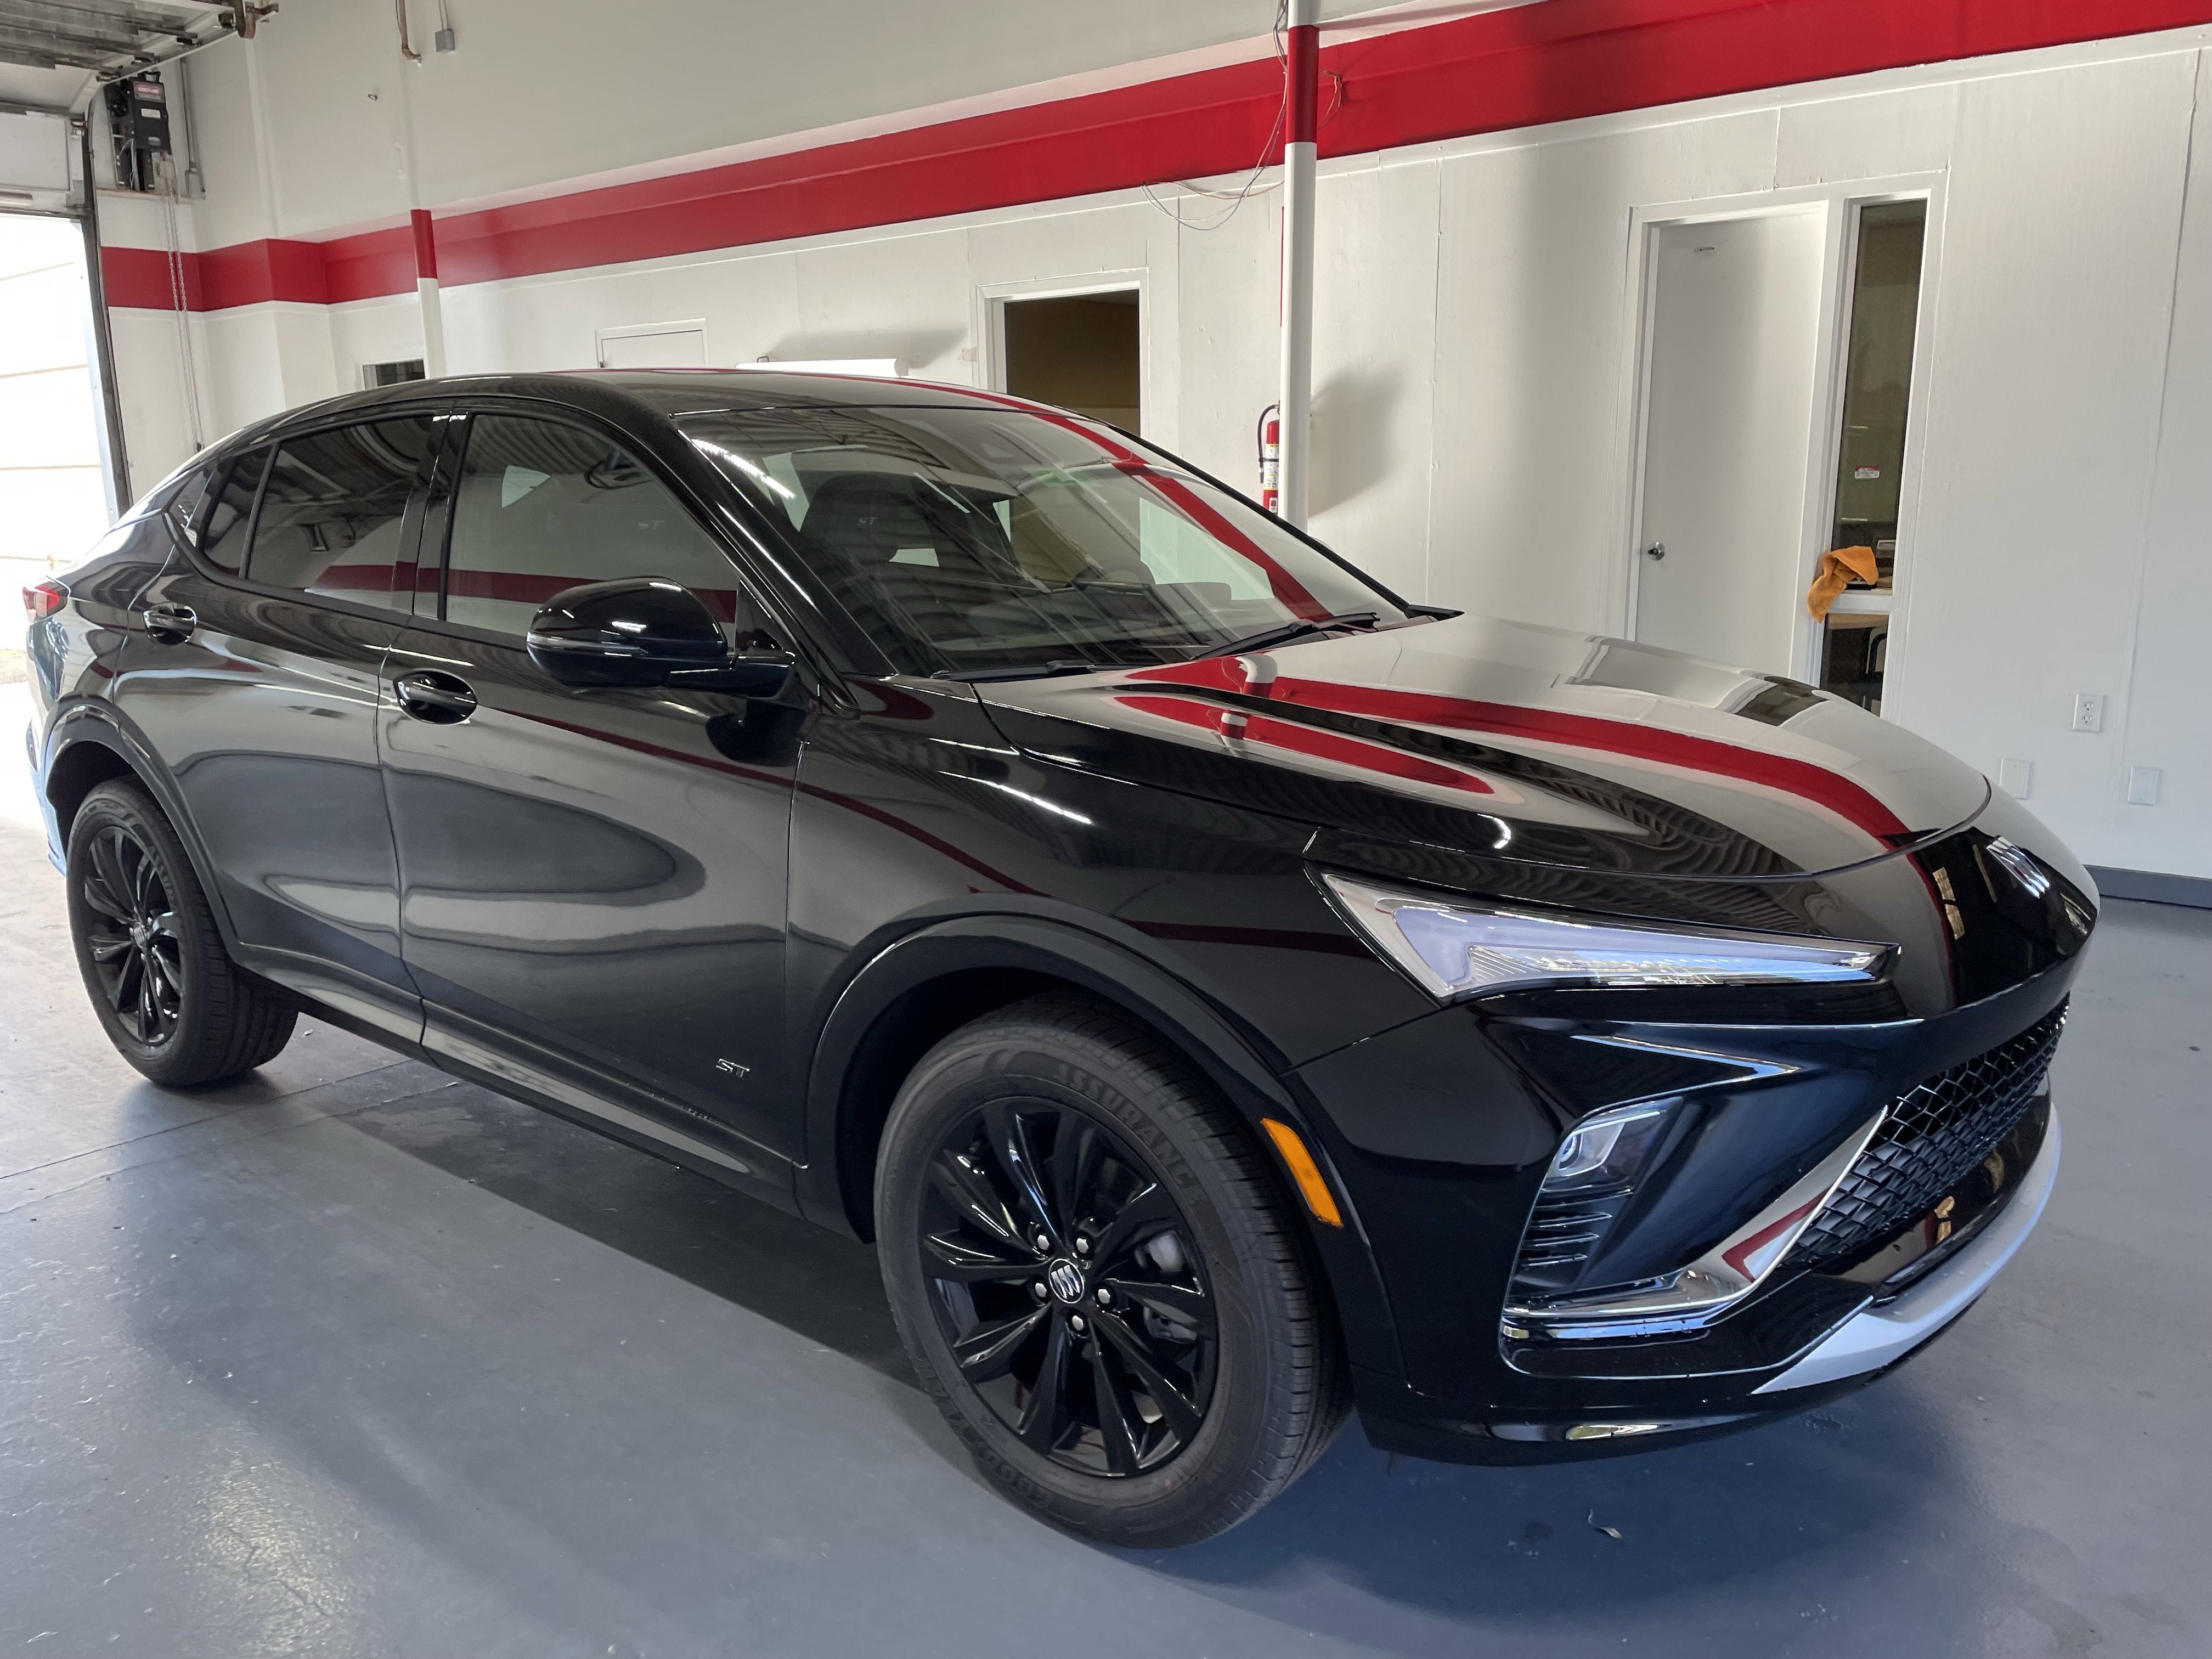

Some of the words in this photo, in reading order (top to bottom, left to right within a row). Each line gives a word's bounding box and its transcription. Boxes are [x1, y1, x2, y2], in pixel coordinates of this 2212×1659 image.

[857, 517, 878, 526] ST
[715, 1058, 750, 1077] ST
[1053, 1062, 1209, 1205] ASSURANCE
